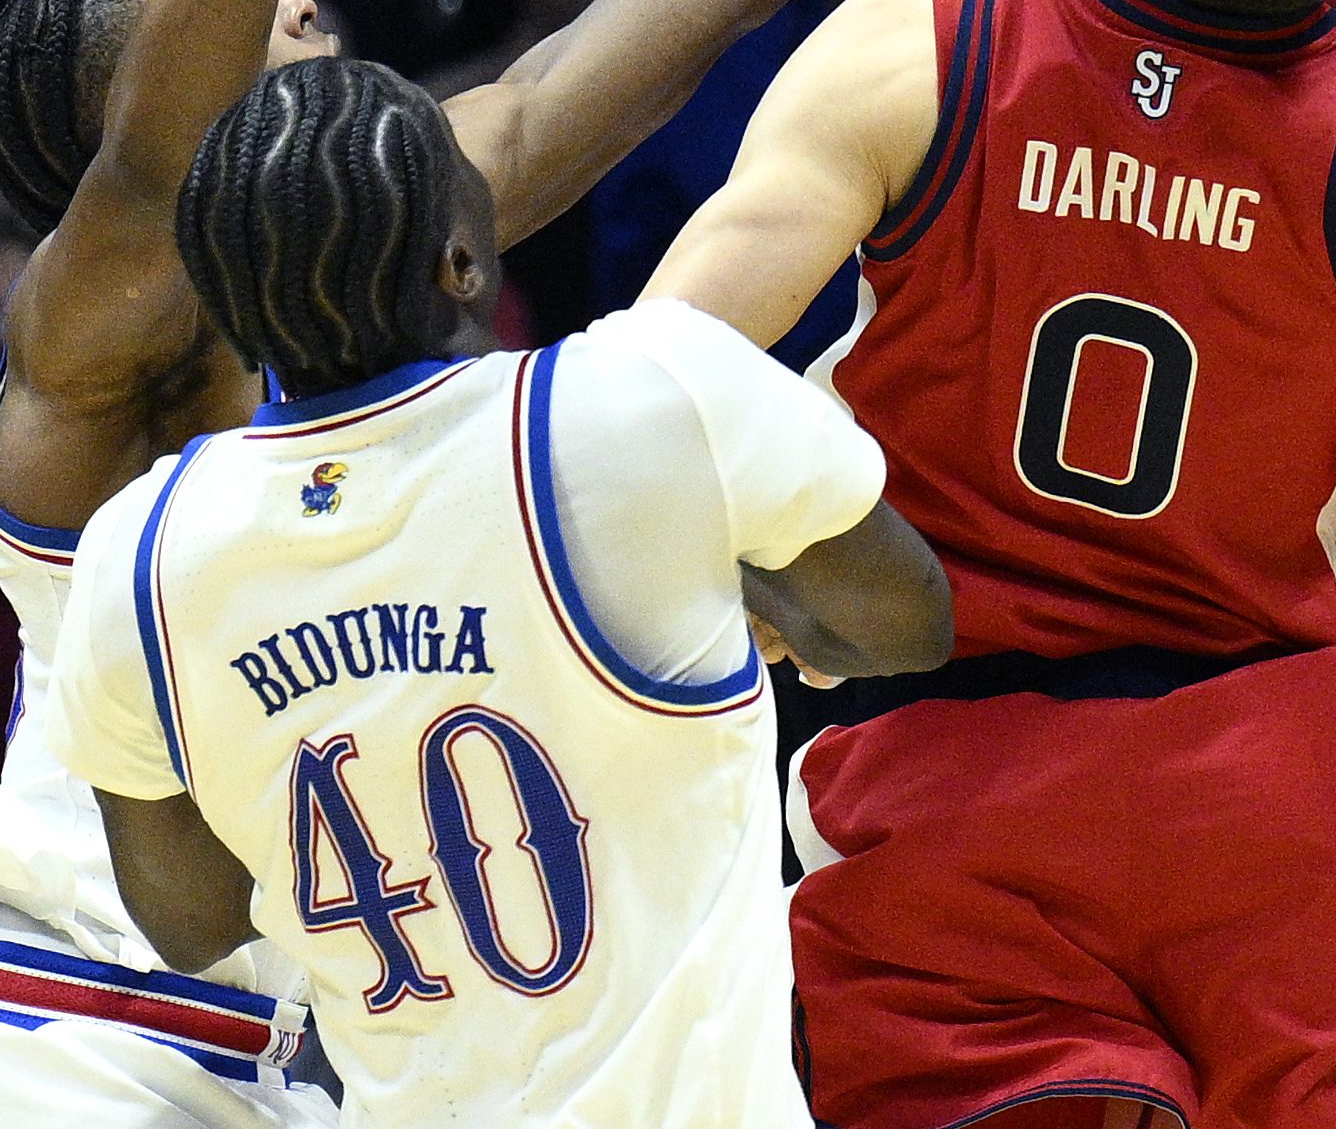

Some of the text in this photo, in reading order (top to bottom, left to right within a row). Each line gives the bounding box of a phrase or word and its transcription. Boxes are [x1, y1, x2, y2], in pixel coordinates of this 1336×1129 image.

[1017, 139, 1261, 252] DARLING
[1012, 292, 1198, 520] 0
[229, 602, 495, 717] BIDUNGA
[287, 703, 595, 1016] 40
